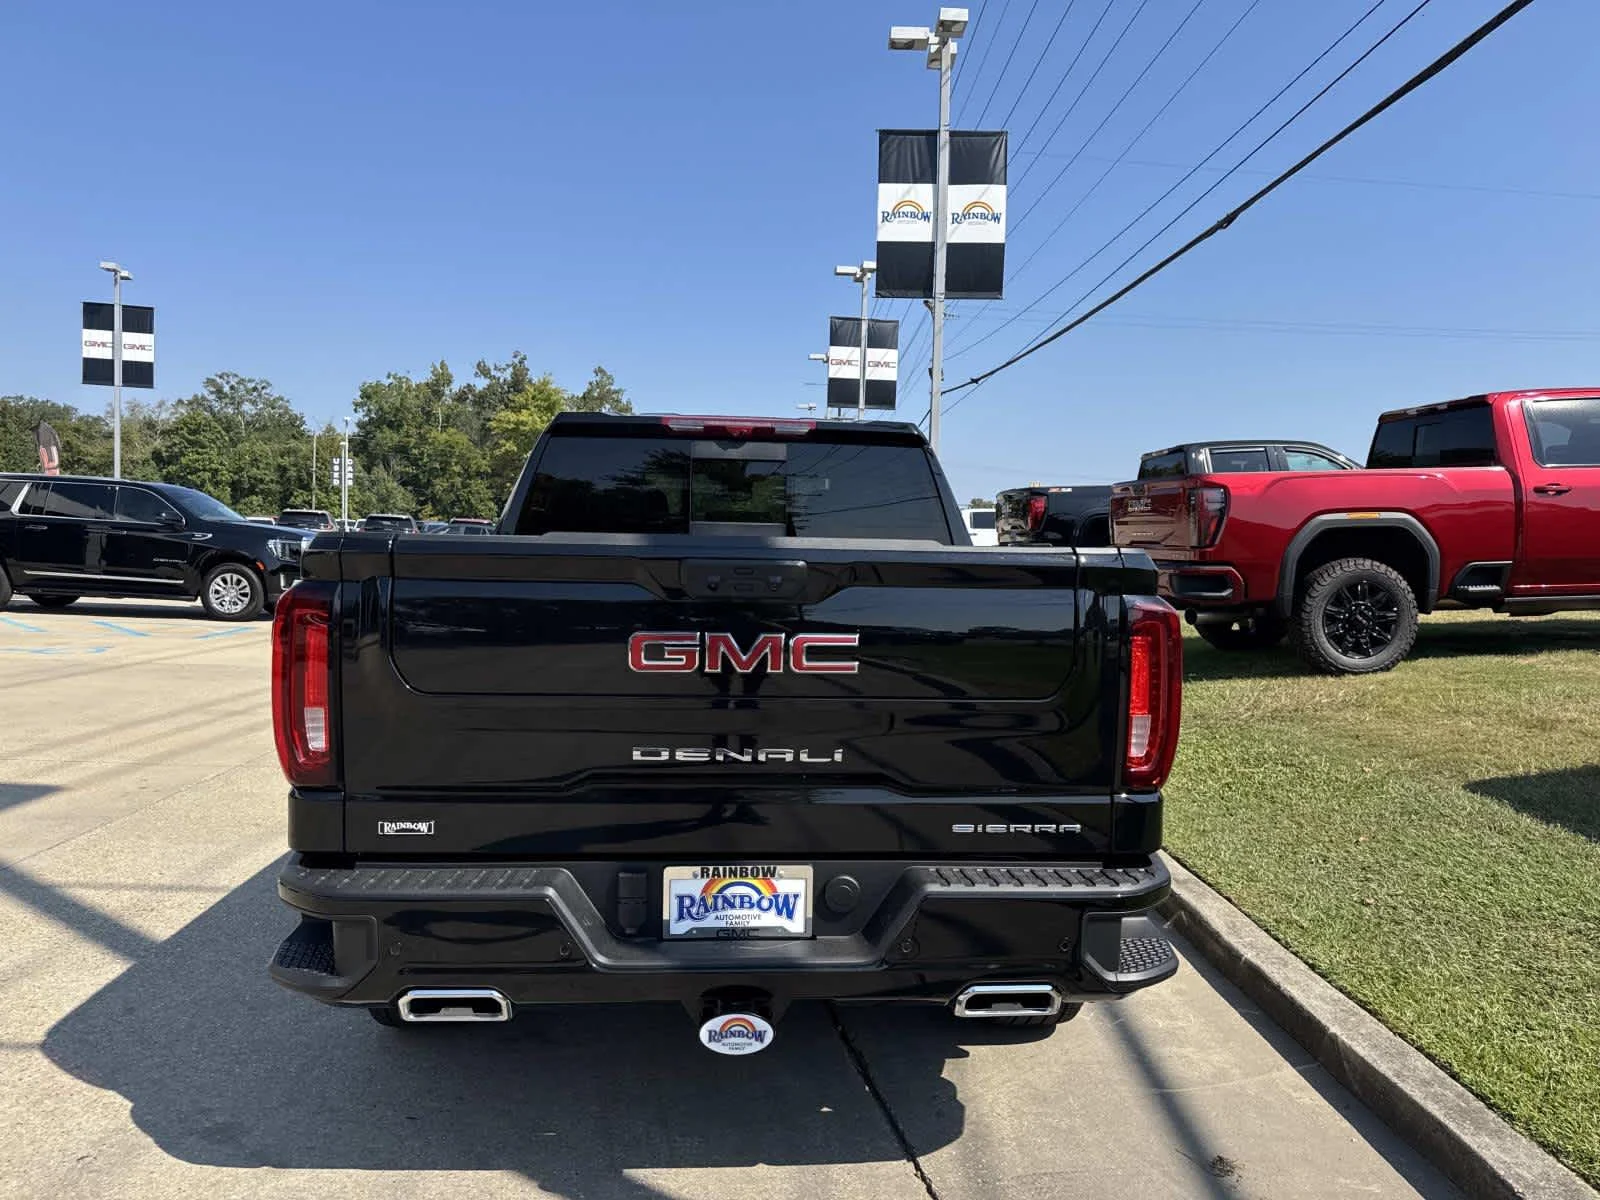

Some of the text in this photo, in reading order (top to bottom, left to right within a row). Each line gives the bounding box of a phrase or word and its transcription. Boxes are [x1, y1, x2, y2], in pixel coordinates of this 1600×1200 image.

[881, 210, 932, 224] RAINBOW
[951, 212, 1002, 225] RAINBOW
[84, 340, 113, 348] GMC
[123, 343, 152, 351] GMC
[830, 359, 859, 367] GMC
[867, 360, 897, 368] GMC
[628, 631, 860, 673] GMC
[632, 747, 844, 762] DENALI
[383, 821, 429, 833] RAINBOW
[952, 824, 1081, 834] SIERRA
[701, 866, 777, 879] RAINBOW
[675, 893, 801, 924] RAINBOW
[716, 928, 760, 938] GMC
[707, 1029, 767, 1044] RAINBOW
